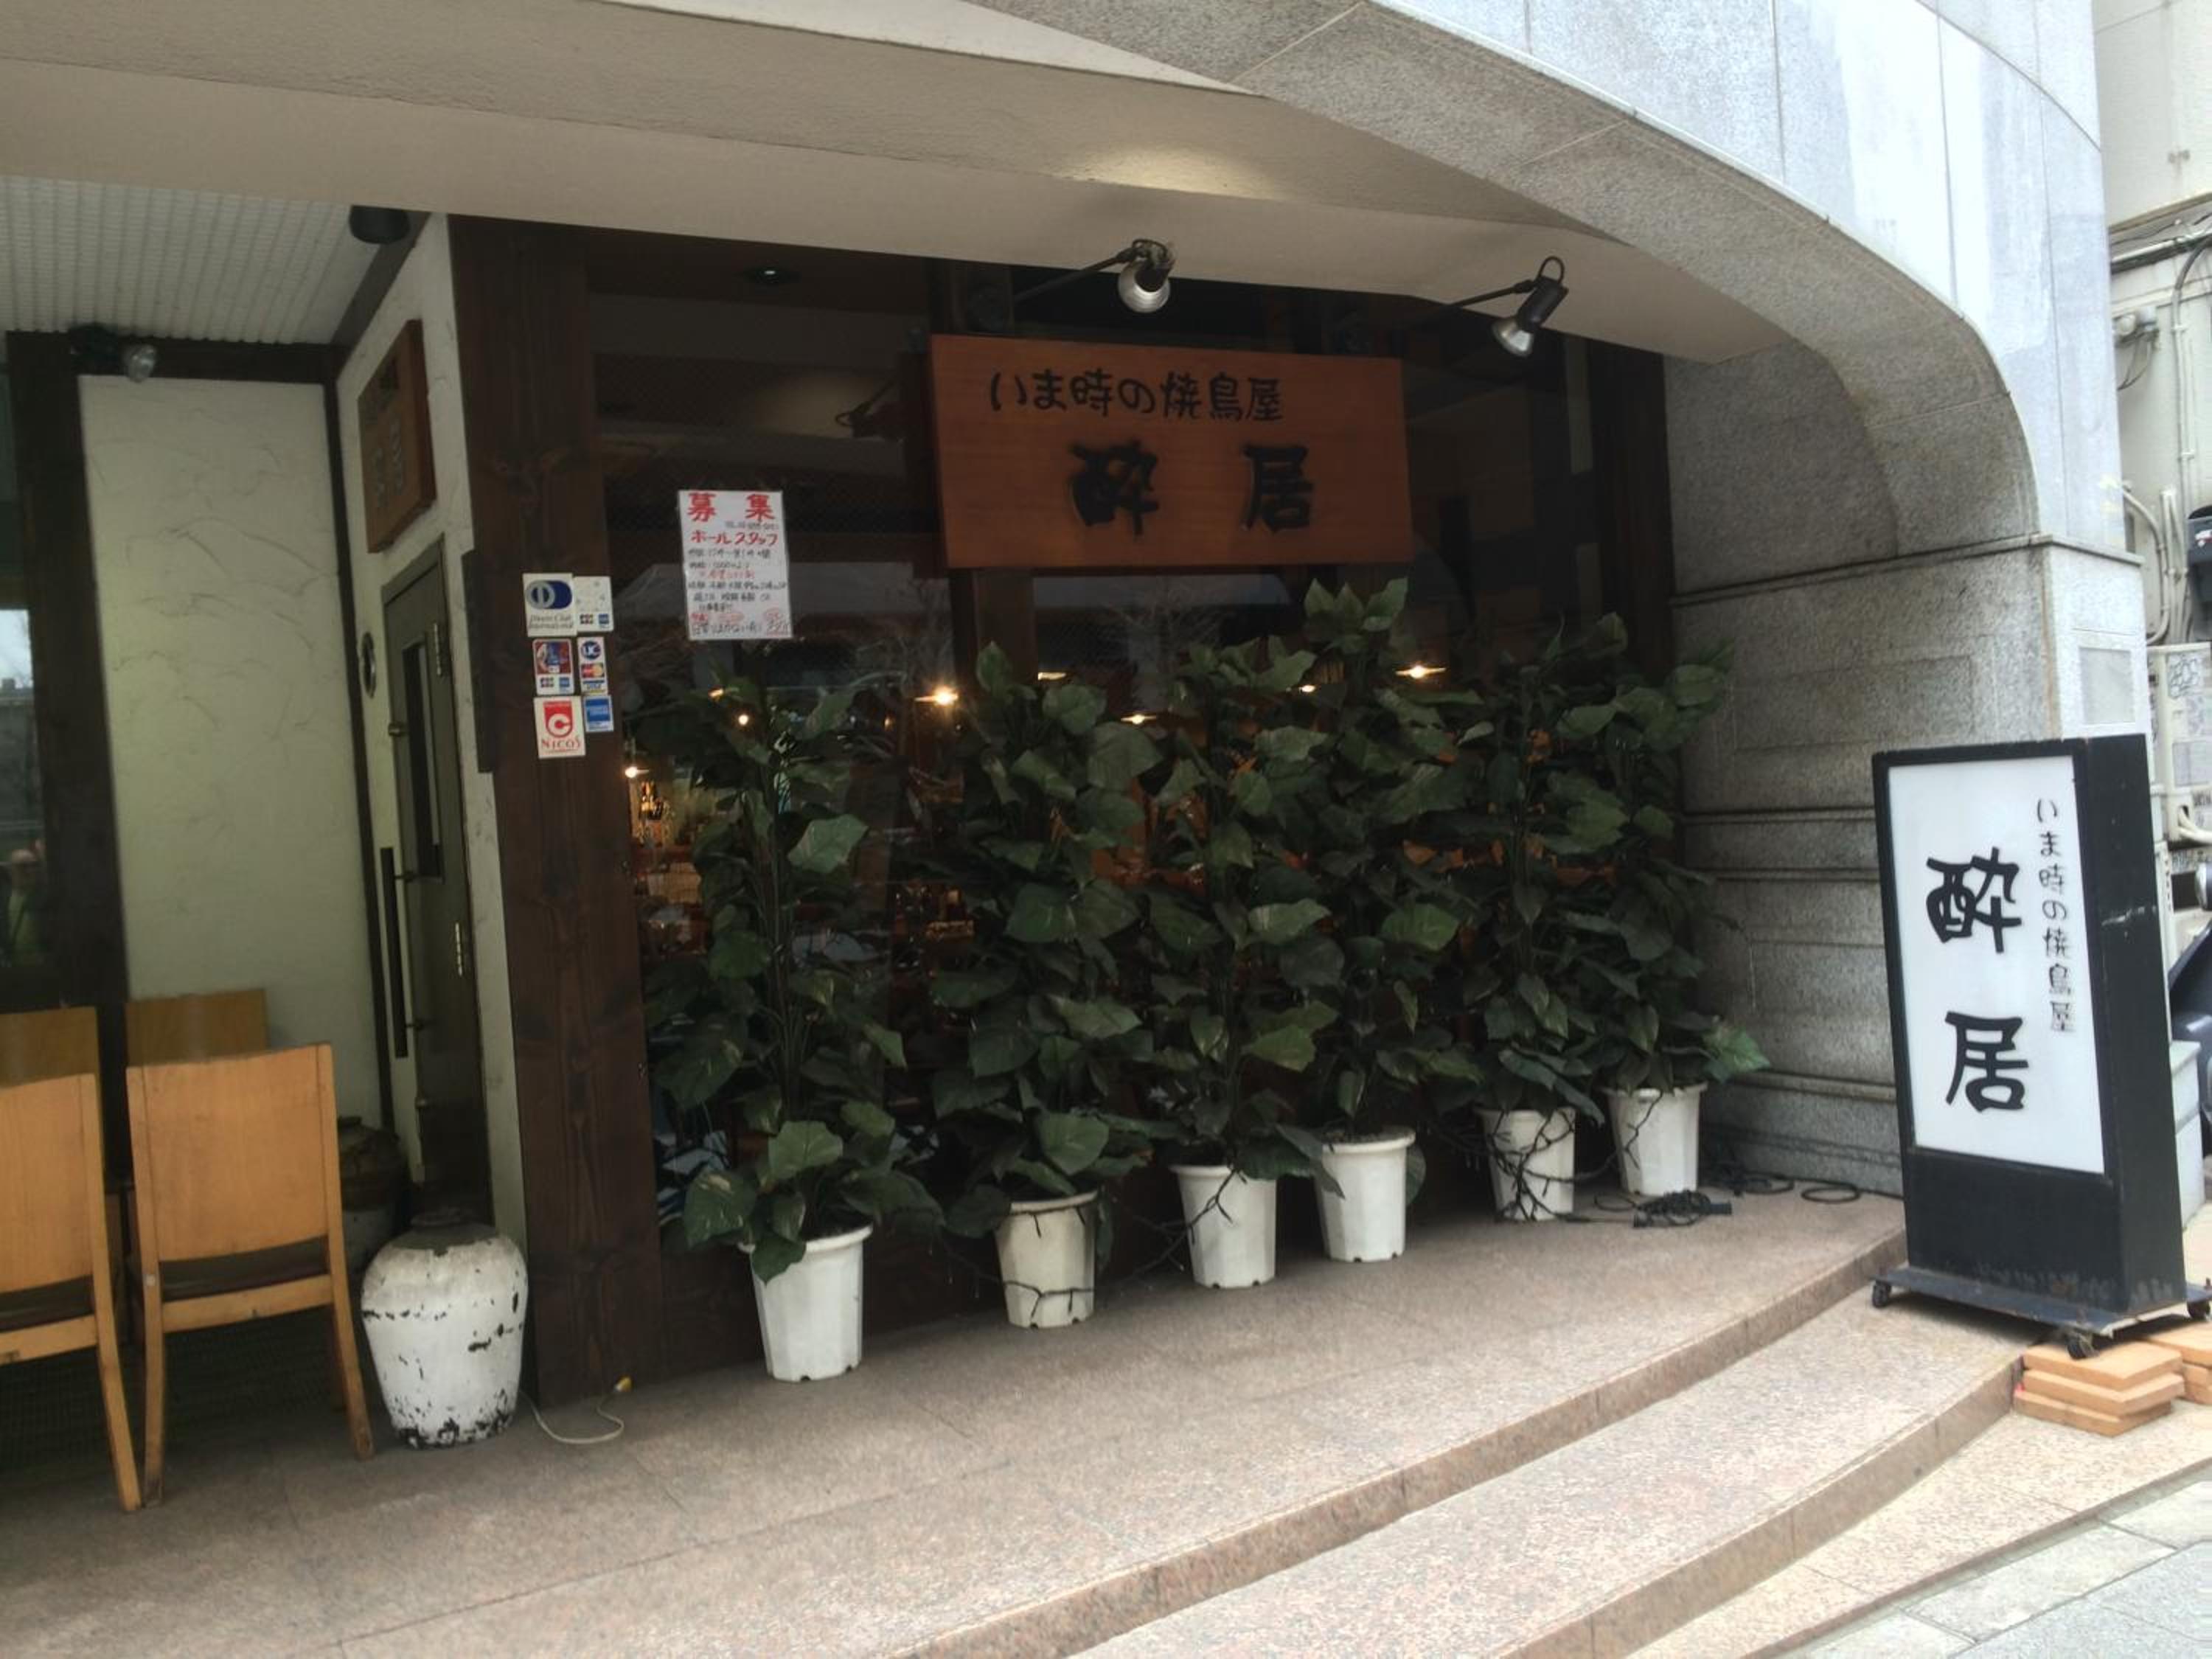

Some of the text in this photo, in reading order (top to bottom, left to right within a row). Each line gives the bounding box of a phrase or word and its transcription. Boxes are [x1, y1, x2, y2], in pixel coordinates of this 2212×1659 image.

[990, 369, 1284, 421] いま時の焼鳥屋
[686, 492, 775, 523] 募集
[691, 529, 779, 546] ホールスタッフ
[541, 737, 580, 750] NICOS
[2037, 799, 2076, 1032] いま時の焼鳥屋
[1926, 846, 2028, 1112] 酔居
